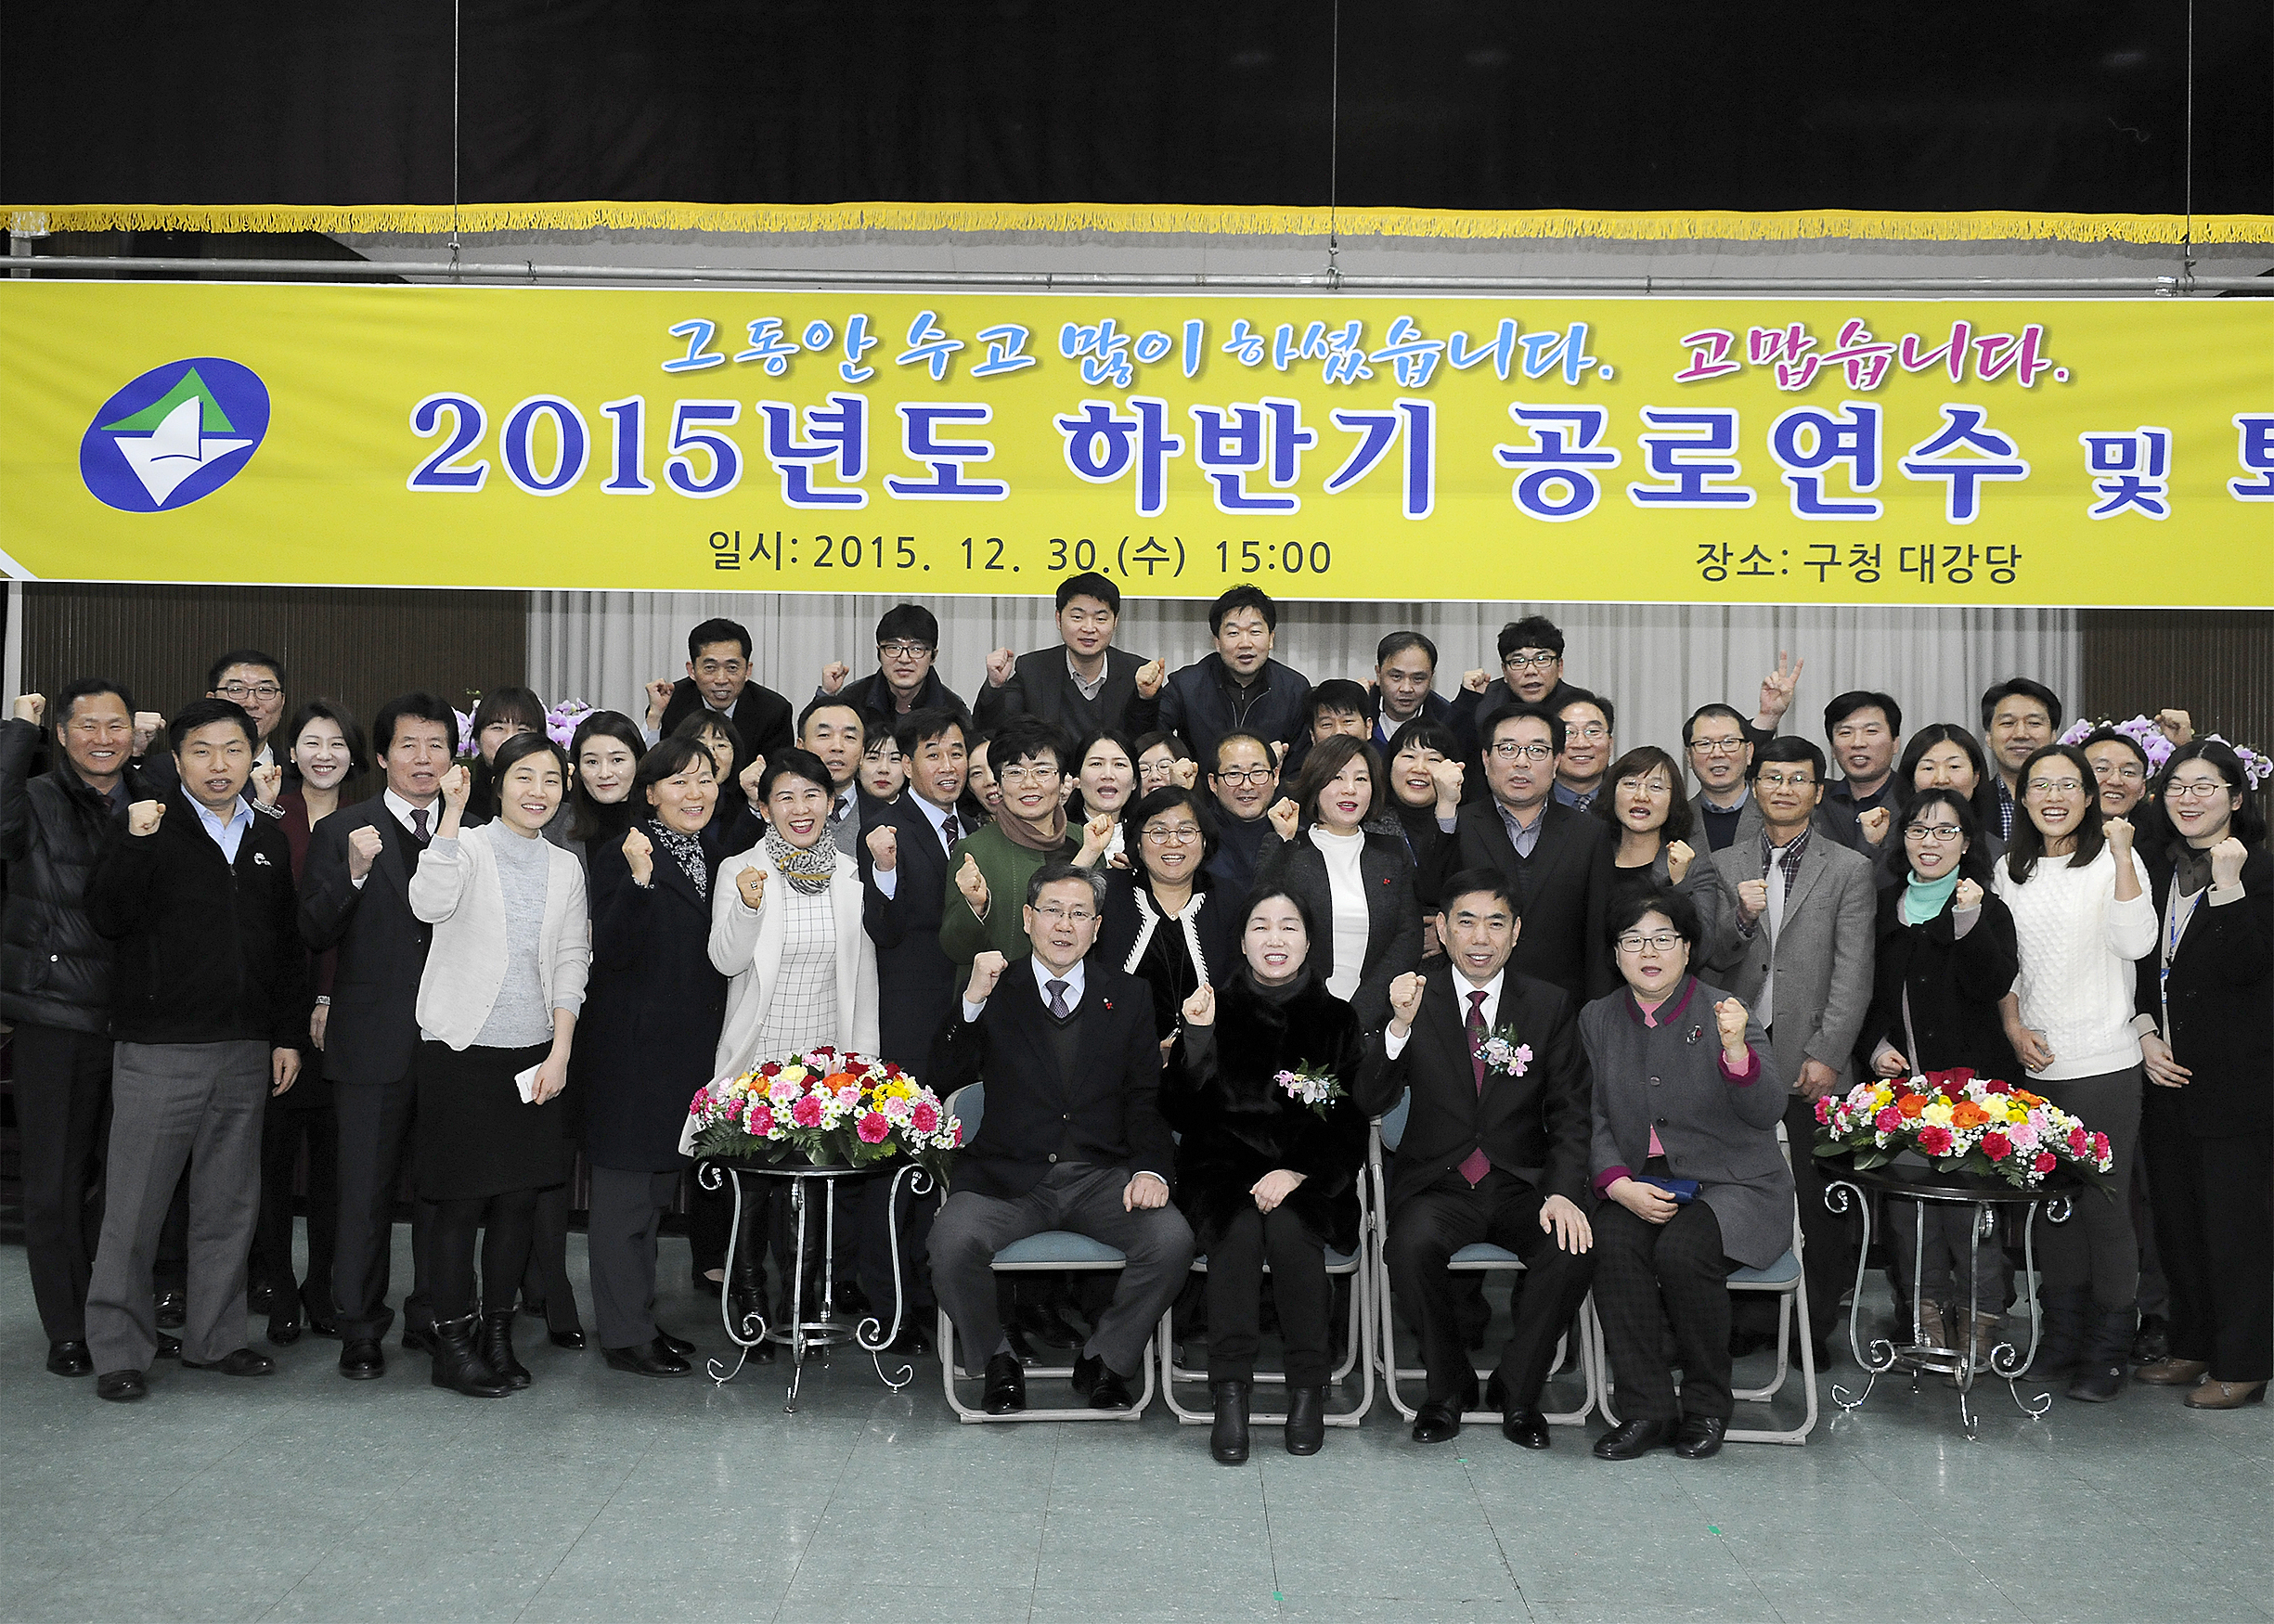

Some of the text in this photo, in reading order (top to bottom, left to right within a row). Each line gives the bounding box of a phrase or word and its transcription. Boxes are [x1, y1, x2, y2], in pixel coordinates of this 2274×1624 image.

[661, 314, 877, 383] 그동안
[895, 310, 1036, 380] 수고
[1058, 318, 1204, 389] 많이
[1674, 318, 2068, 390] 고맙습니다.
[409, 393, 1007, 508] 2015년도
[1055, 397, 1433, 518] 하반기
[1495, 403, 2027, 522] 공로연수
[2082, 428, 2169, 518] 및
[709, 530, 798, 571] 일시:
[813, 535, 930, 572] 2015.
[961, 537, 1020, 573] 12.
[1216, 540, 1331, 574] 15:00
[1693, 541, 2022, 585] 장소: 구청 대강당
